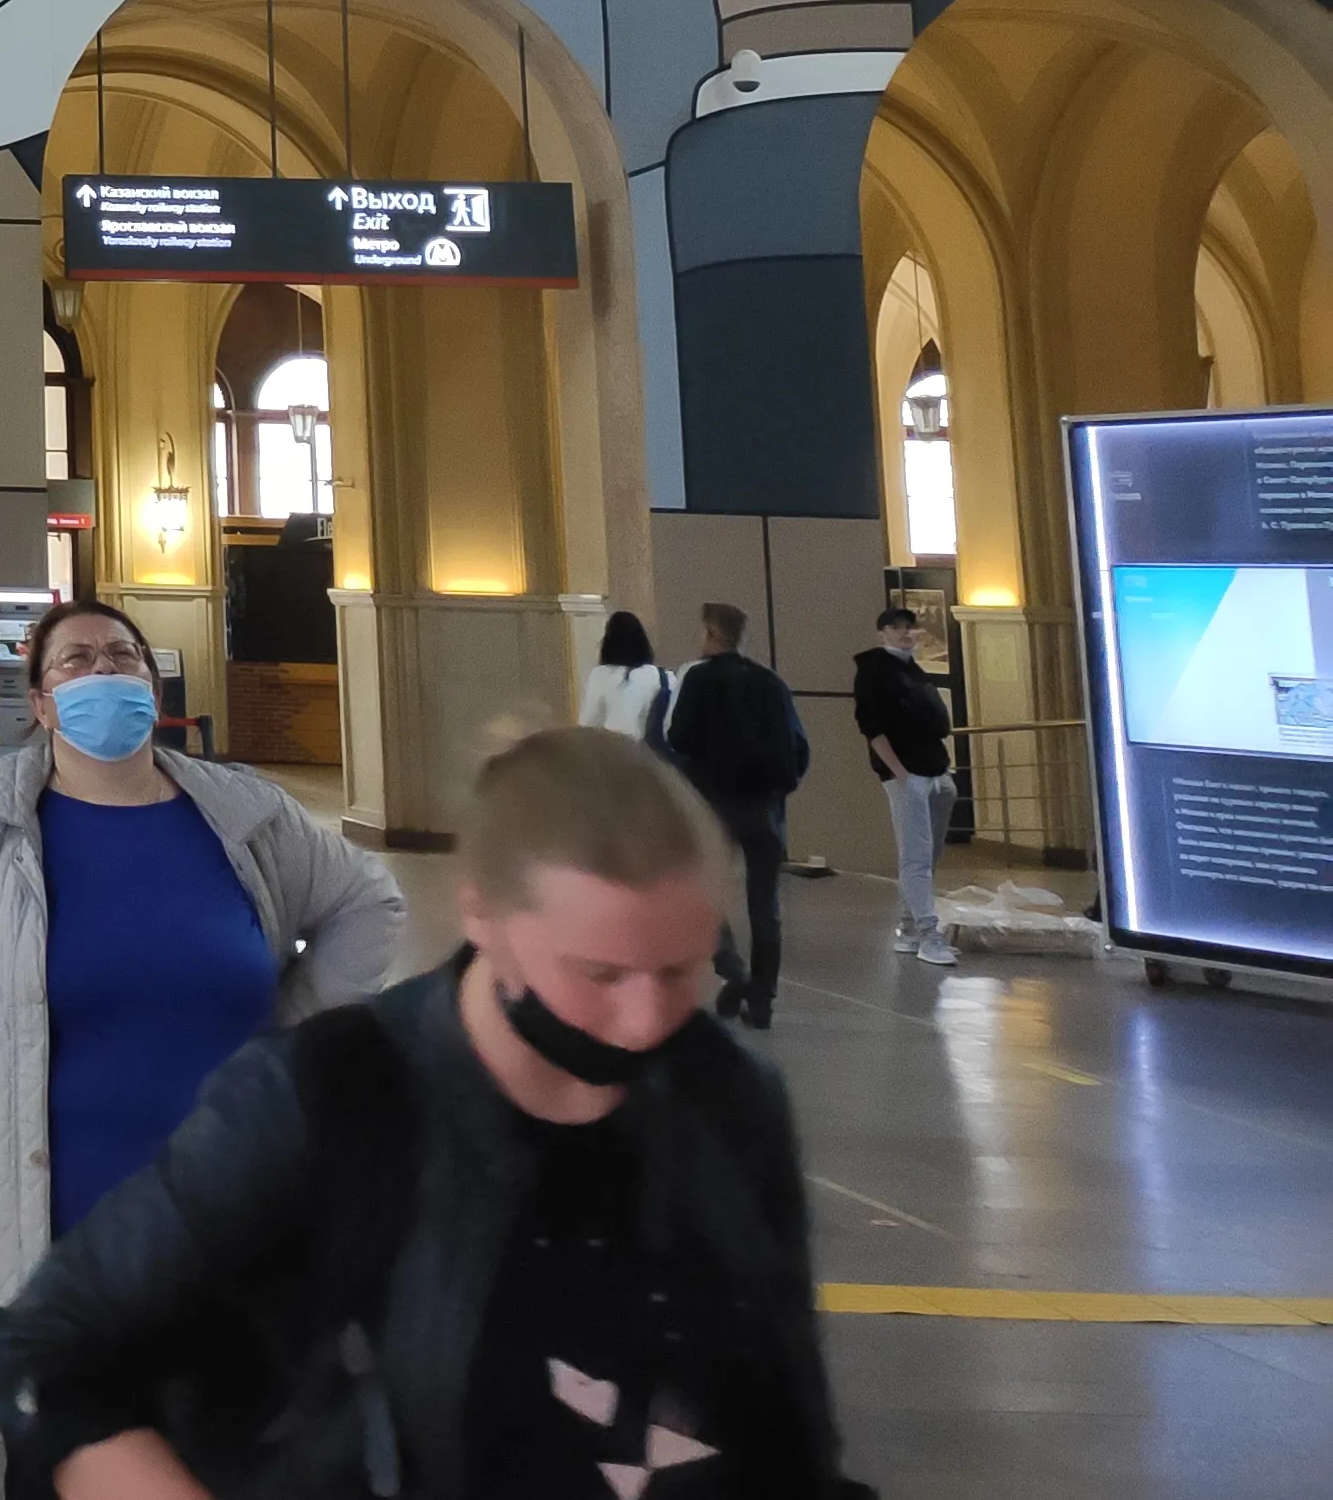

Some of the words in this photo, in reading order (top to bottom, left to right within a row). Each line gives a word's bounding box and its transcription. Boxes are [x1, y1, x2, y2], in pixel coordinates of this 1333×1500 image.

[100, 185, 171, 199] Казанский
[172, 189, 220, 200] вокзал
[351, 187, 437, 215] Выход
[101, 219, 188, 234] Ярославский
[189, 223, 236, 234] вокзал
[353, 213, 391, 230] Exit
[353, 237, 400, 253] Метро
[354, 254, 422, 267] Underground
